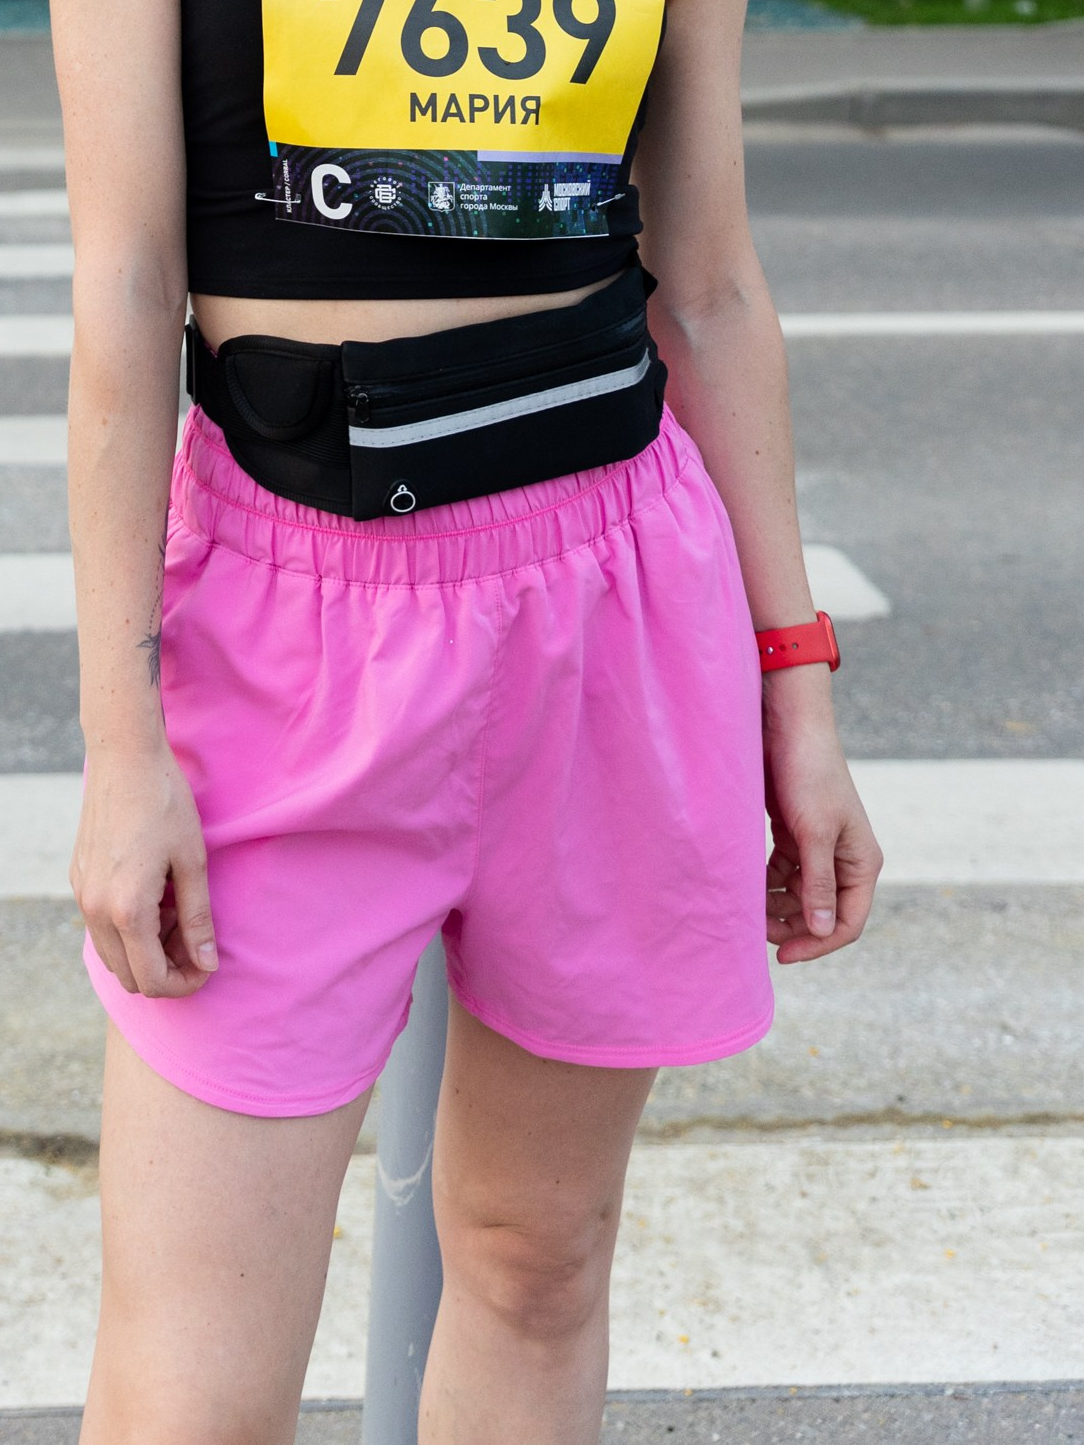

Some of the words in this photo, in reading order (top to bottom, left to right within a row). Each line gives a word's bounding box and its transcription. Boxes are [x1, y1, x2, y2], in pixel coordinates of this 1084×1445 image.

[410, 92, 541, 126] МАРИЯ
[459, 184, 512, 192] Департамент
[459, 194, 488, 202] спорта
[460, 203, 488, 211] города
